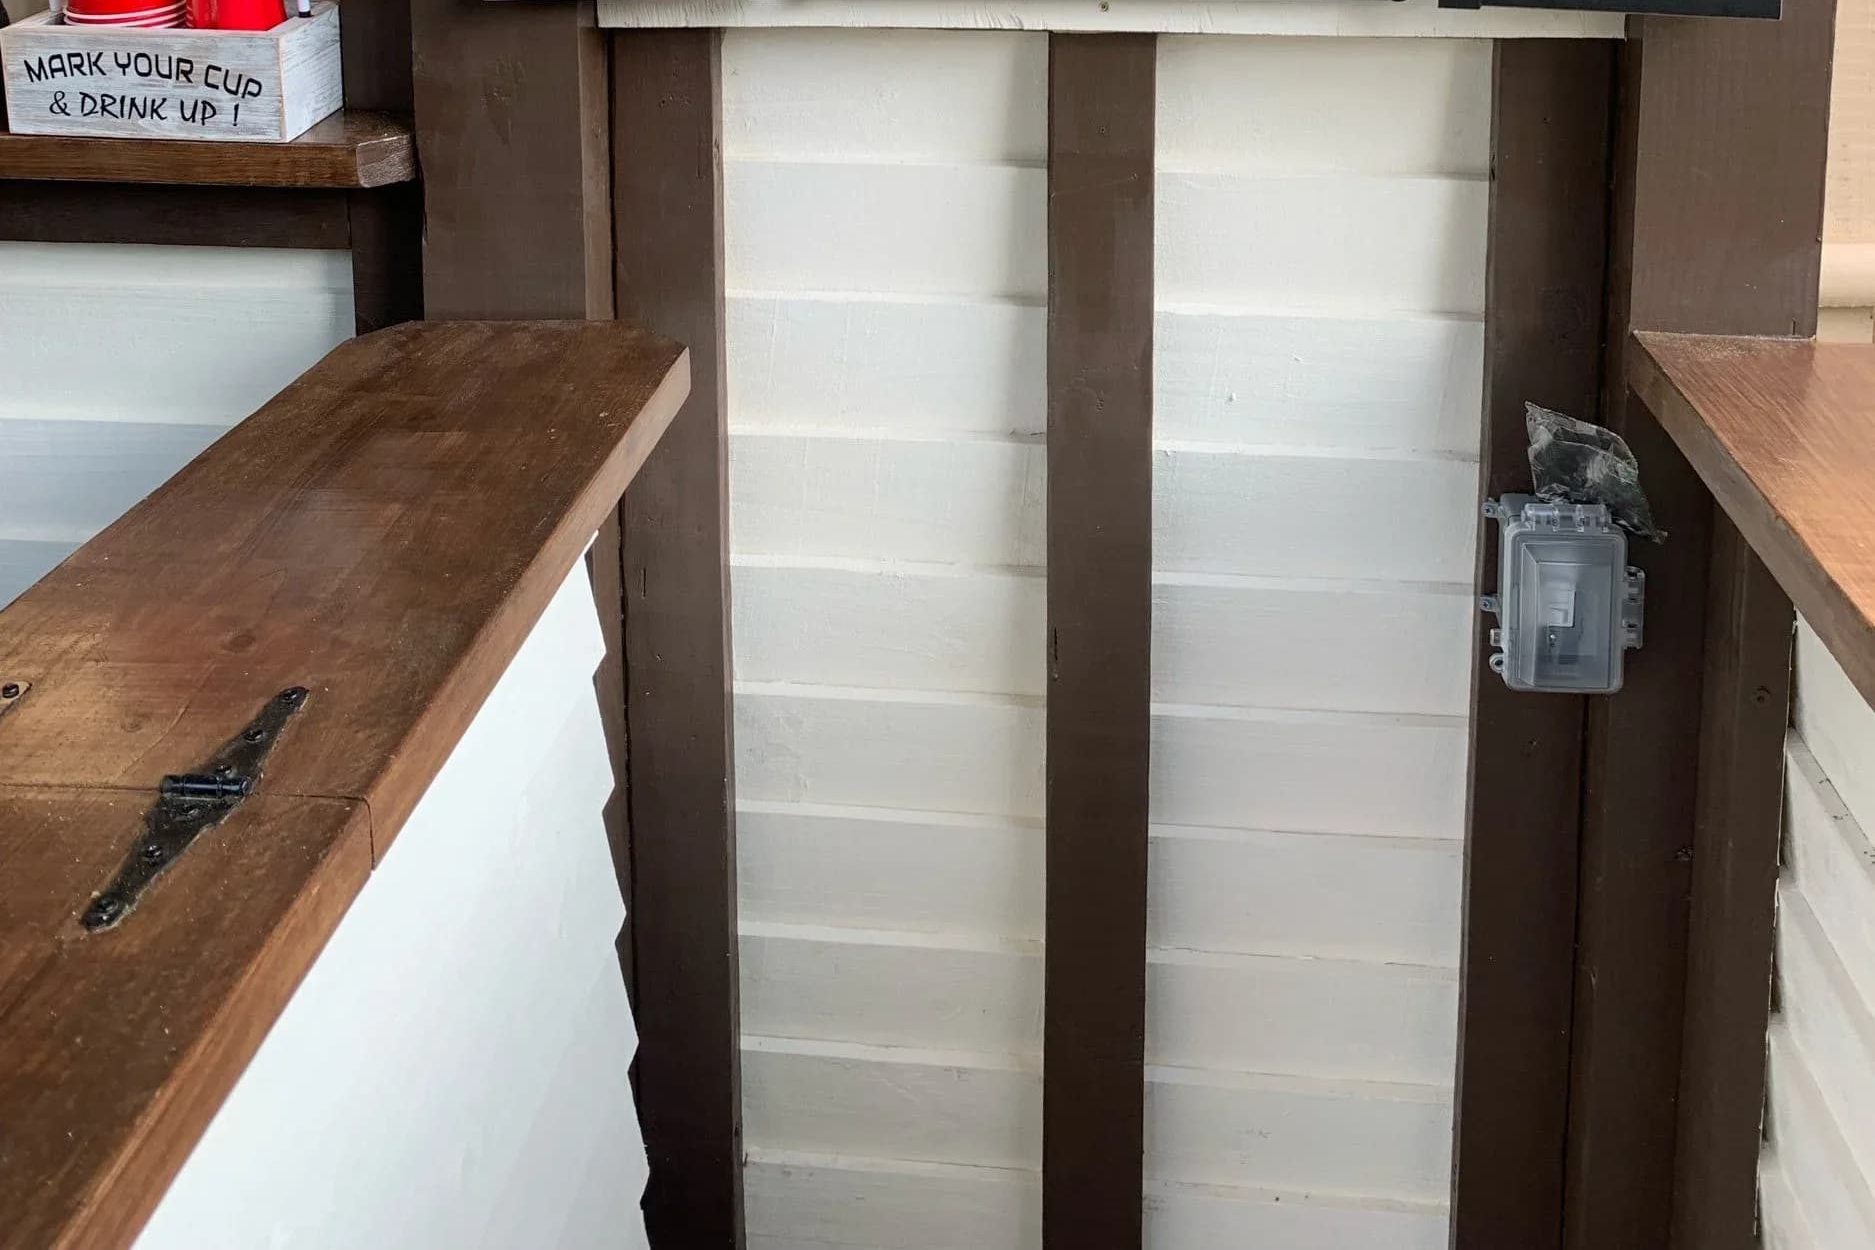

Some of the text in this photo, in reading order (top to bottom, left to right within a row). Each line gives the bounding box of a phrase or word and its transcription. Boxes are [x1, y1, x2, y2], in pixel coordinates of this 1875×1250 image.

[24, 52, 263, 99] MARK YOUR CUP
[49, 91, 240, 126] & DRINK UP !
